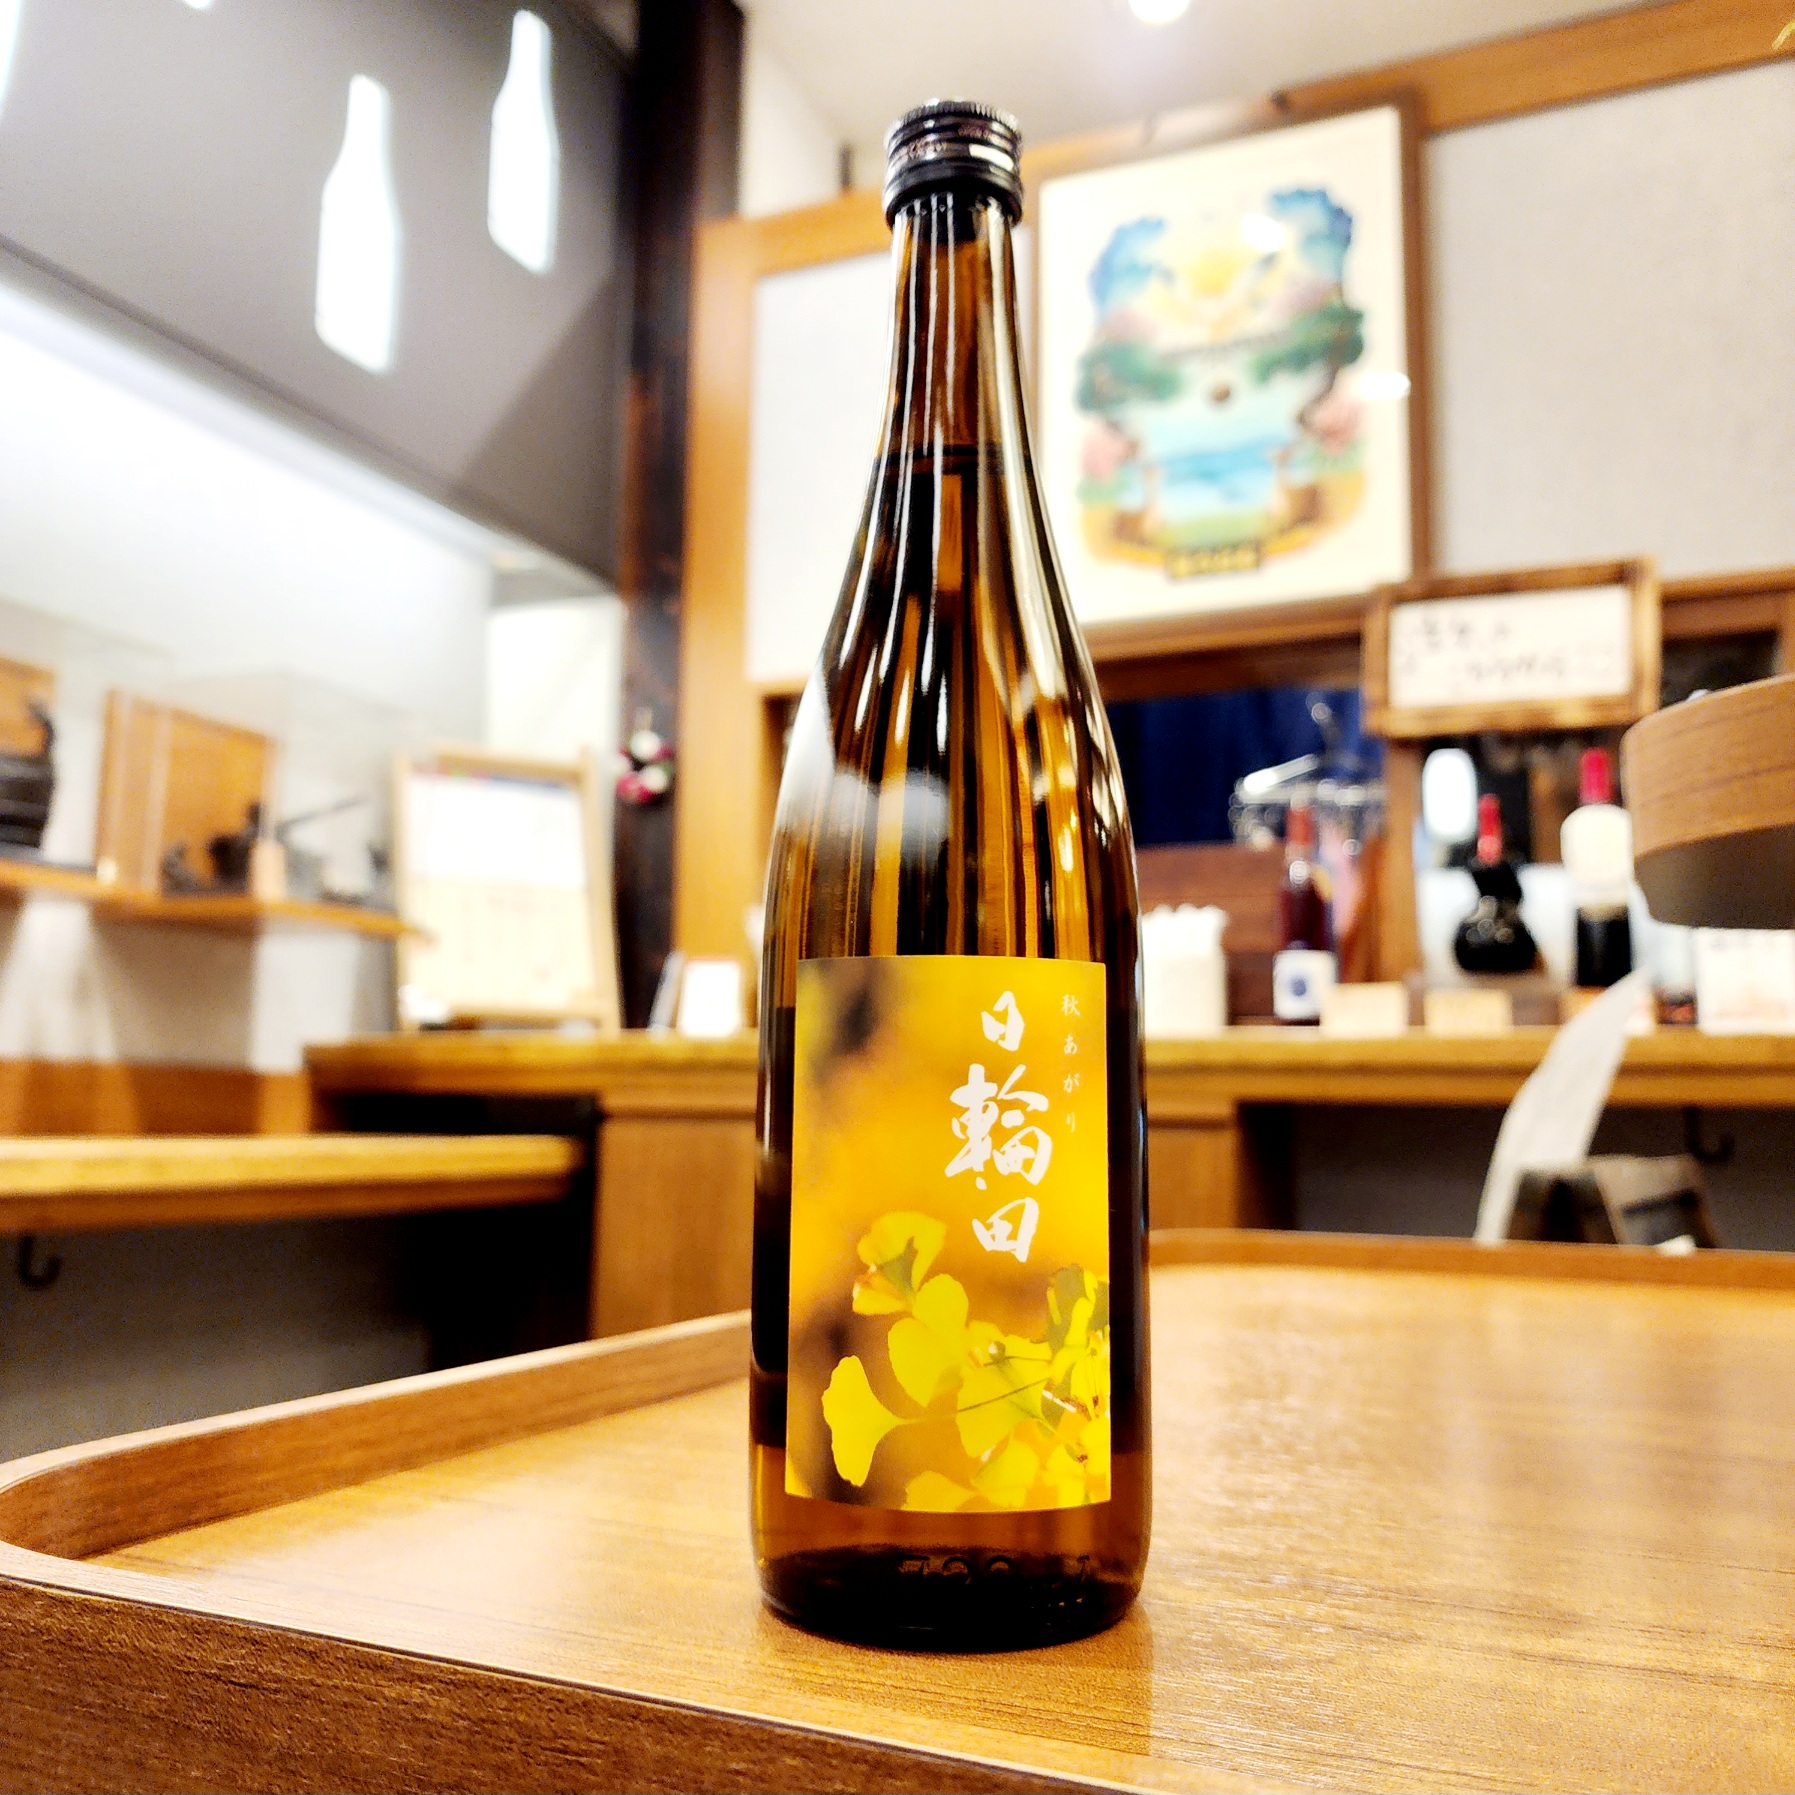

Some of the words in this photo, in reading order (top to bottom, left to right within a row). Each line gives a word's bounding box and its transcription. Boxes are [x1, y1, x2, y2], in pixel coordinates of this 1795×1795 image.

[944, 990, 1052, 1263] 日輪田
[1060, 994, 1081, 1134] 秋あがり
